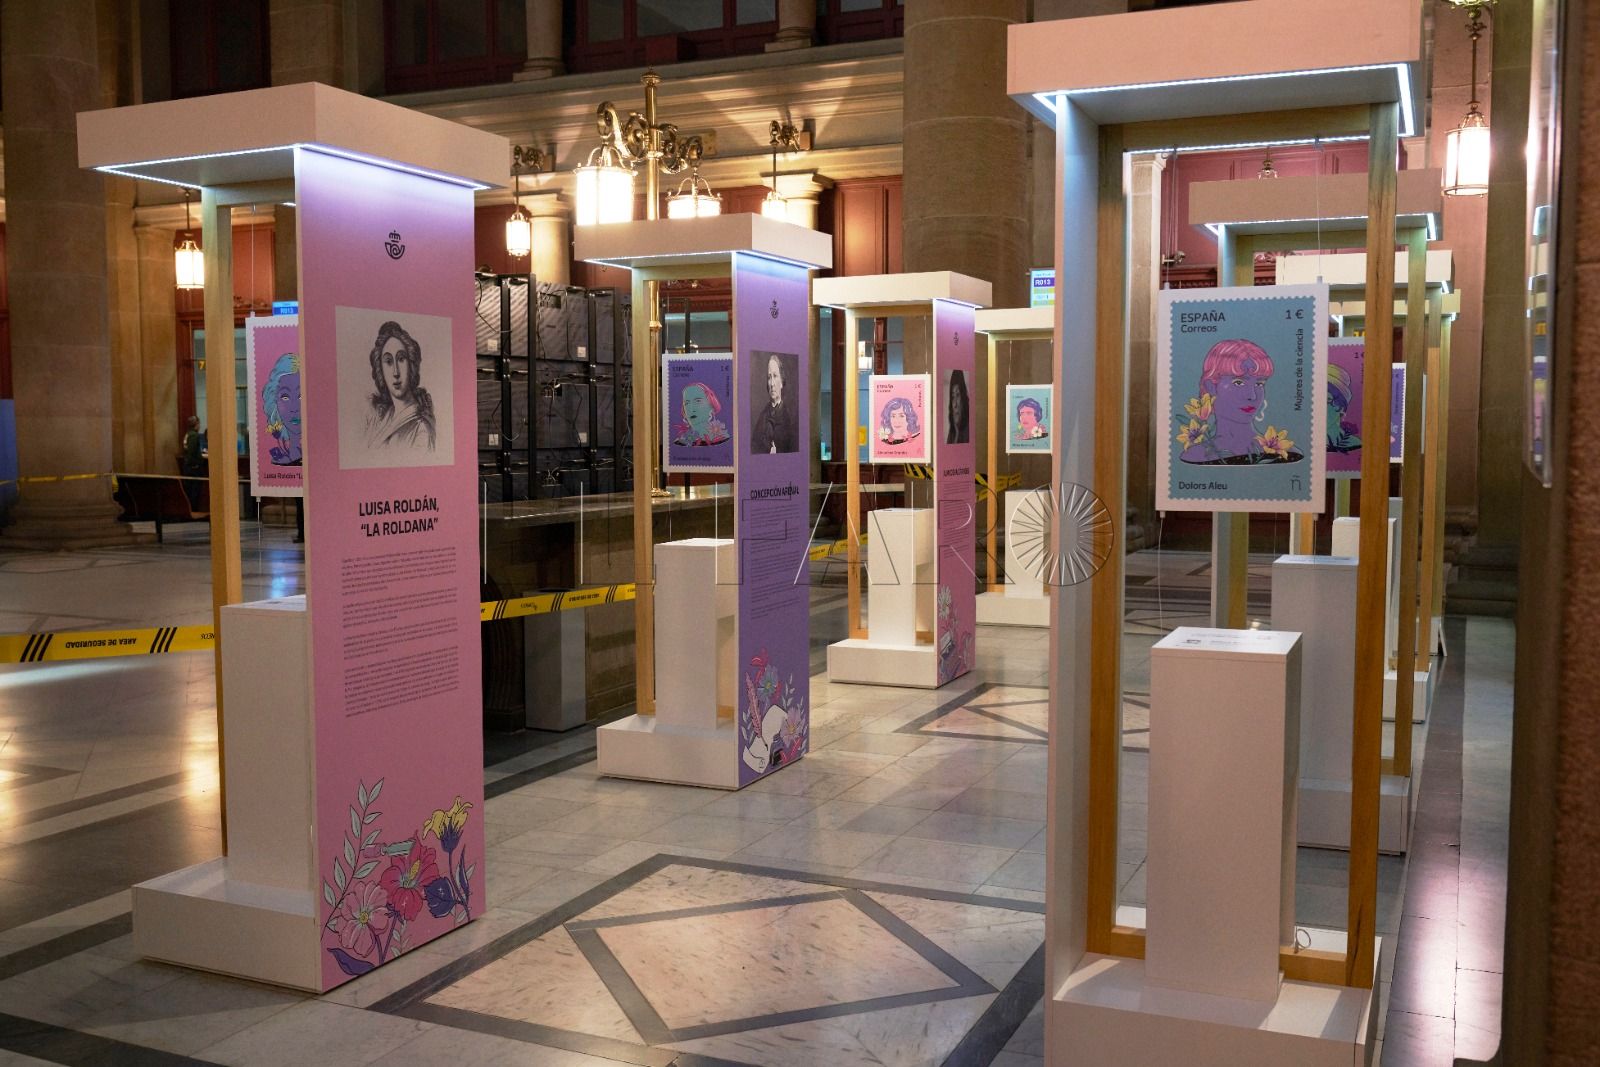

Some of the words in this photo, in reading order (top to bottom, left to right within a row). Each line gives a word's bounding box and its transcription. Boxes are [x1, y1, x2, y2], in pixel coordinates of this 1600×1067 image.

[1180, 309, 1226, 323] ESPAÑA
[1285, 310, 1292, 320] 1
[1295, 309, 1304, 320] €
[1180, 324, 1217, 333] Correos
[1295, 328, 1304, 357] ciencia
[1295, 358, 1304, 366] la
[1295, 367, 1304, 378] de
[1294, 378, 1305, 411] Mujeres
[1178, 481, 1207, 490] Dolors
[1207, 481, 1228, 490] Aleu
[750, 486, 782, 499] CONCEPCIÓN
[359, 500, 392, 517] LUISA
[393, 494, 440, 514] ROLDÁN,
[361, 522, 381, 537] “LA
[382, 517, 439, 536] ROLDANA”
[65, 639, 107, 649] SEGURIDAD
[107, 639, 118, 647] DE
